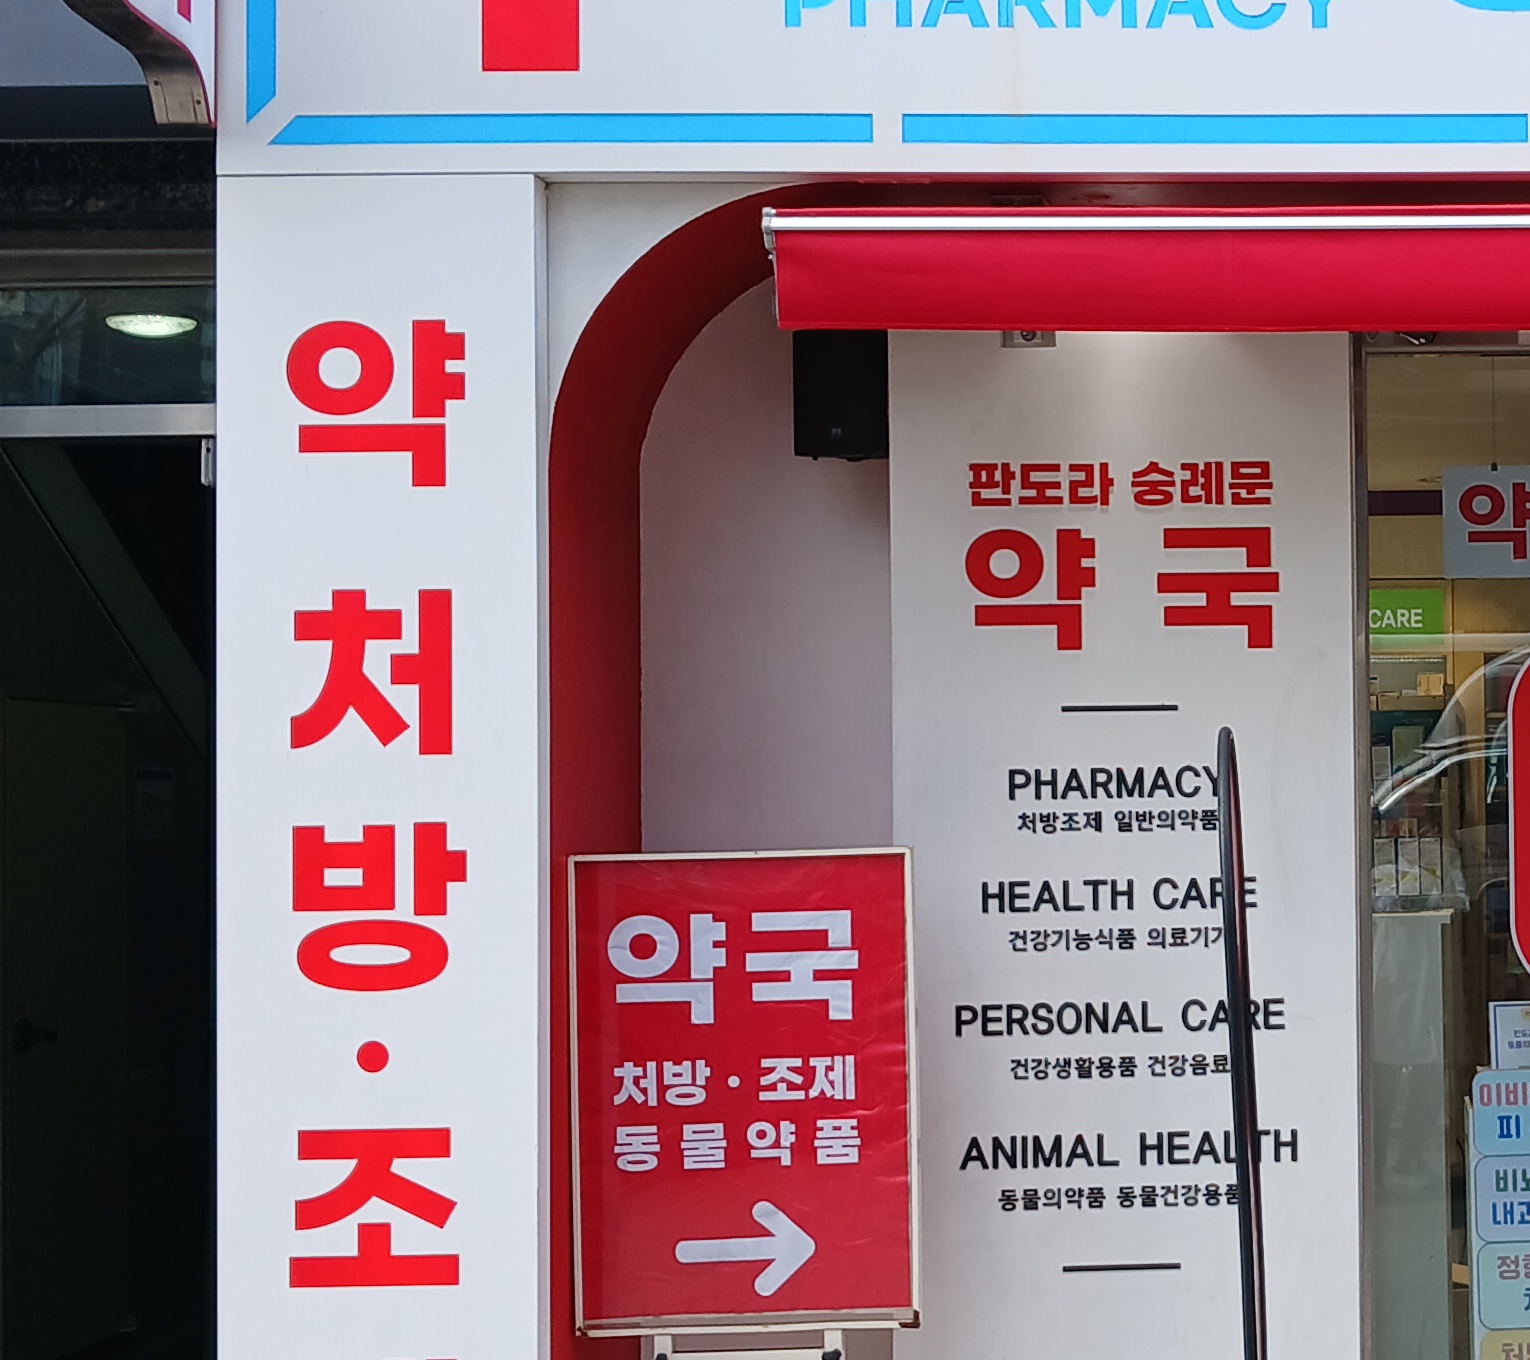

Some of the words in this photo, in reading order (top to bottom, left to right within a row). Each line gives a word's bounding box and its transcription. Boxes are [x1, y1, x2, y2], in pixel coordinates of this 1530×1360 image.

[286, 319, 466, 487] 약
[968, 461, 1114, 507] 판도라
[1131, 460, 1273, 506] 숭례문
[965, 526, 1280, 651] 약국
[1369, 609, 1423, 628] CARE
[1017, 811, 1102, 833] 처방조제
[981, 878, 1135, 914] HEALTH
[1008, 927, 1137, 952] 건강기능식품
[607, 909, 859, 1024] 약국
[953, 1000, 1163, 1038] PERSONAL
[1010, 1057, 1137, 1081] 건강생활용품
[1148, 1054, 1231, 1077] 건강음료
[959, 1133, 1120, 1171] ANIMAL
[998, 1188, 1106, 1213] 동물의약품
